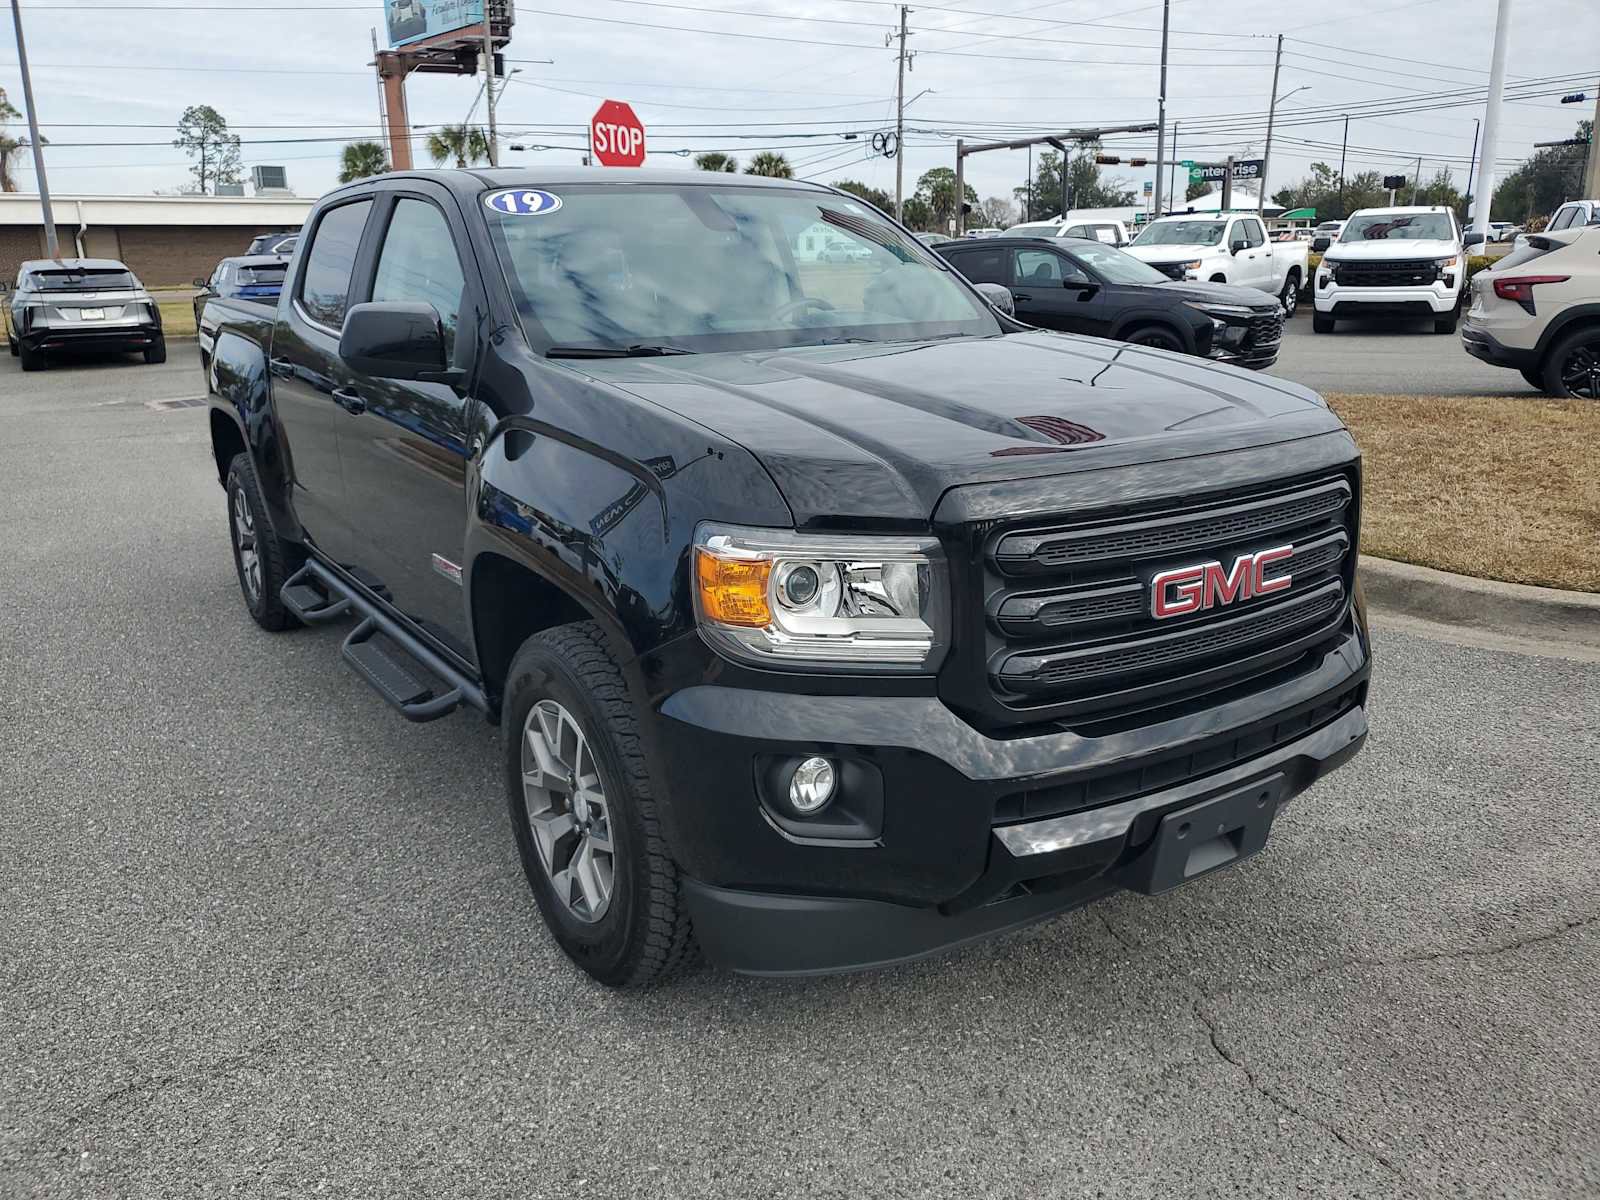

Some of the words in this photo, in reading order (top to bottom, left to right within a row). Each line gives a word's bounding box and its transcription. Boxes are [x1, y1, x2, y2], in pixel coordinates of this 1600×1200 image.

[595, 122, 643, 157] STOP
[1191, 163, 1258, 178] enterrise
[501, 192, 543, 212] 19
[1151, 544, 1293, 620] GMC
